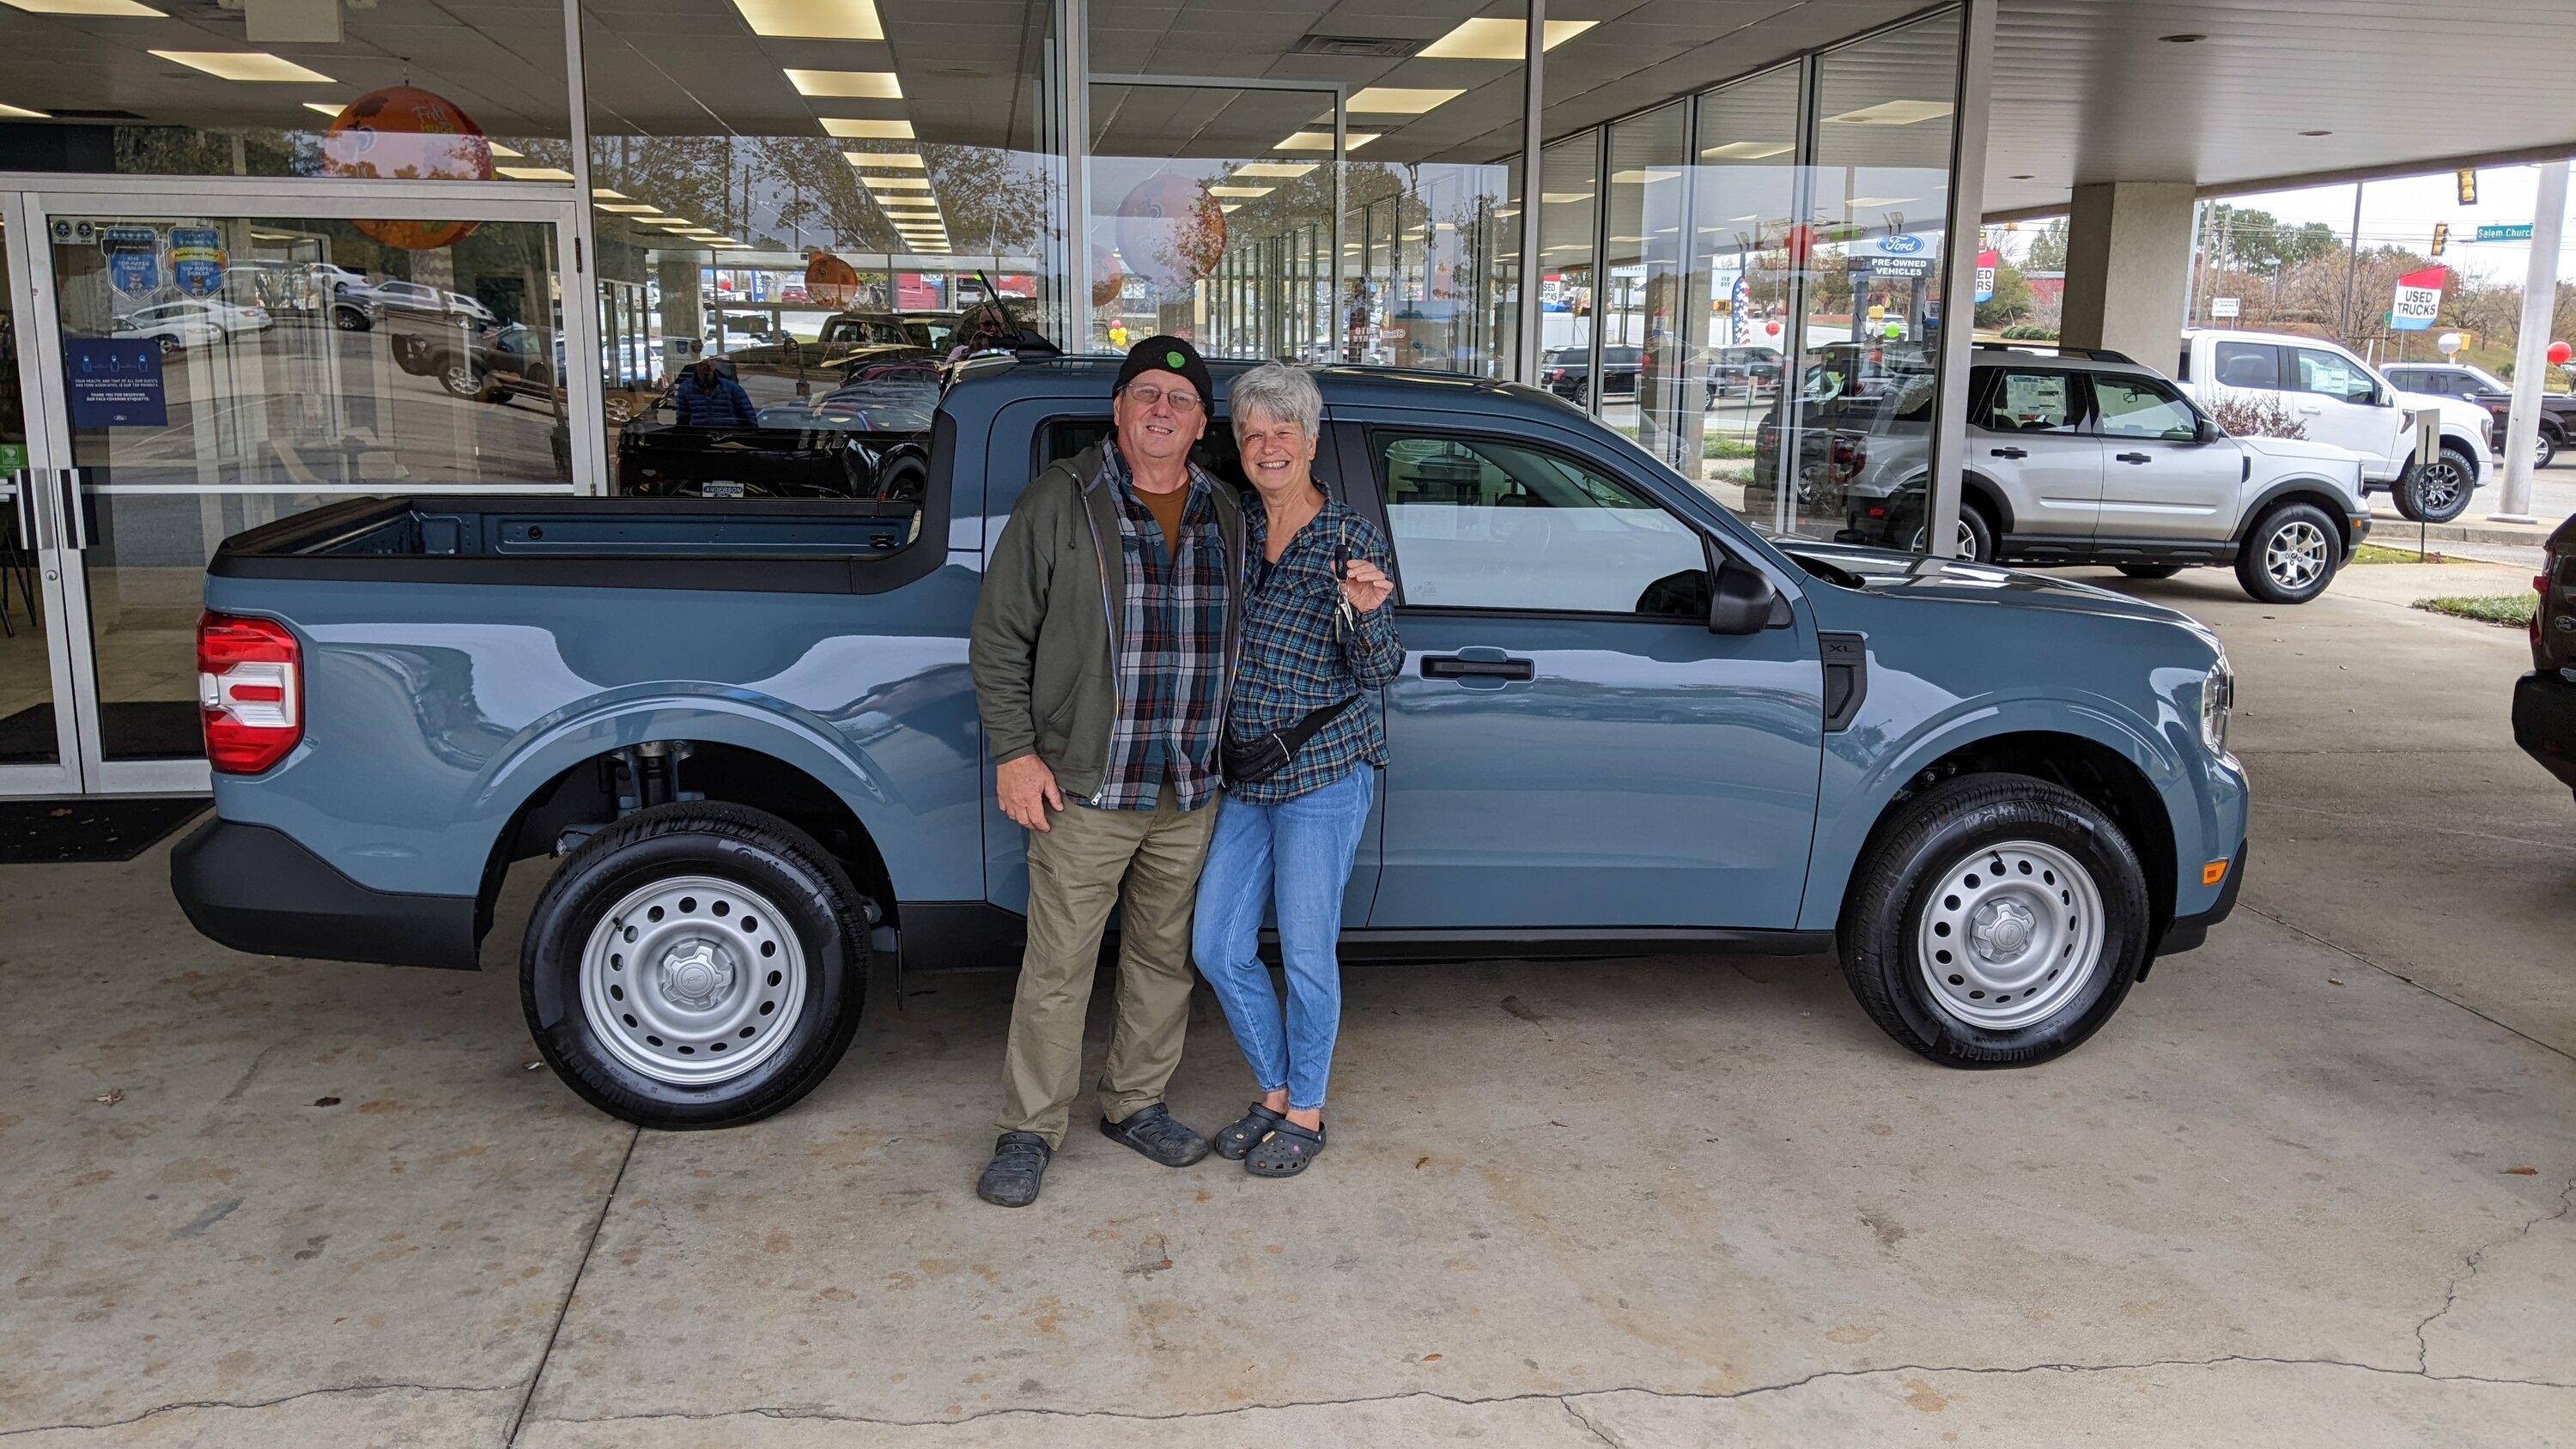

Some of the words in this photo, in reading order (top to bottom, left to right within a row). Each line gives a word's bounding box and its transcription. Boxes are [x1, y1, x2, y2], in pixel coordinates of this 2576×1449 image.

[2478, 228, 2503, 239] Salem
[1886, 235, 1917, 252] Ford
[1872, 258, 1927, 268] PRE-OWNED
[1875, 267, 1923, 276] VEHICLES
[1977, 270, 1992, 279] ED
[1543, 282, 1555, 292] SED
[1976, 281, 1992, 291] RS
[2405, 290, 2433, 303] USED
[2397, 302, 2436, 316] TRUCKS
